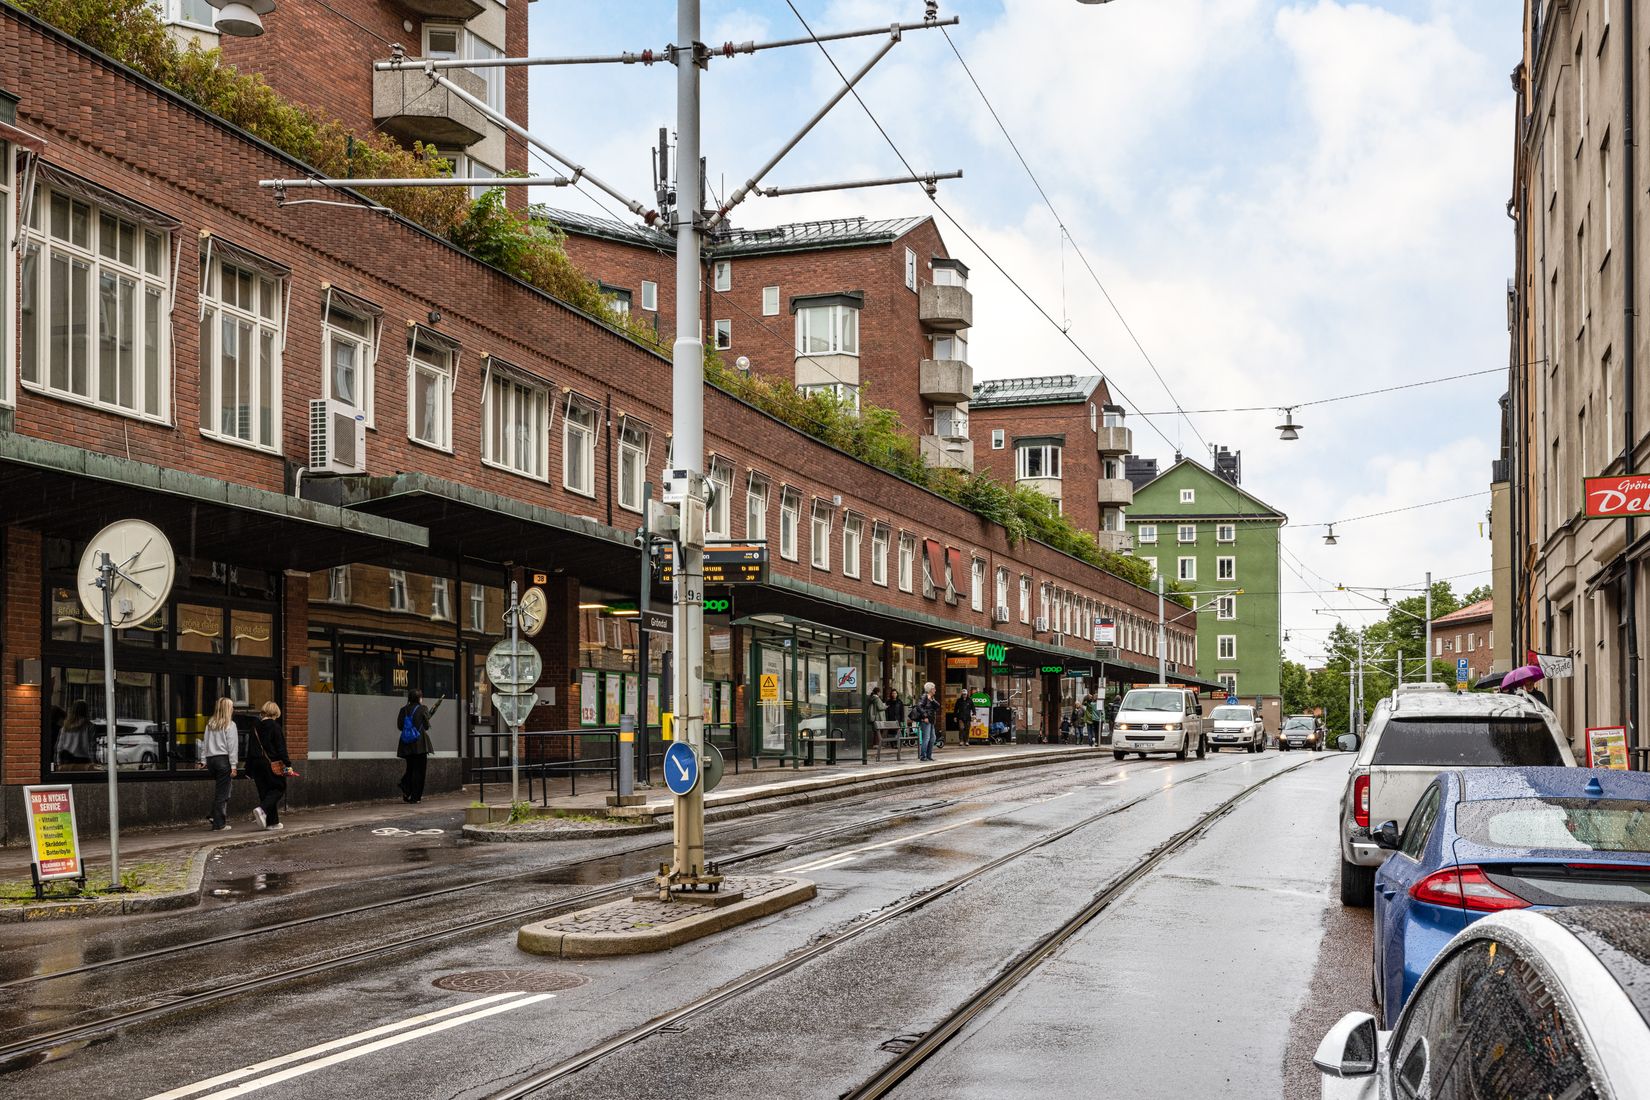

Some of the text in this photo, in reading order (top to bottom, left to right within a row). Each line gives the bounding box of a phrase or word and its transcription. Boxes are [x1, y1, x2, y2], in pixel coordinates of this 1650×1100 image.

[702, 600, 729, 612] oop
[650, 617, 668, 629] Gröndal
[986, 643, 1006, 666] coop
[1459, 659, 1467, 668] P
[1041, 666, 1063, 674] coop
[40, 802, 61, 812] SERVICE
